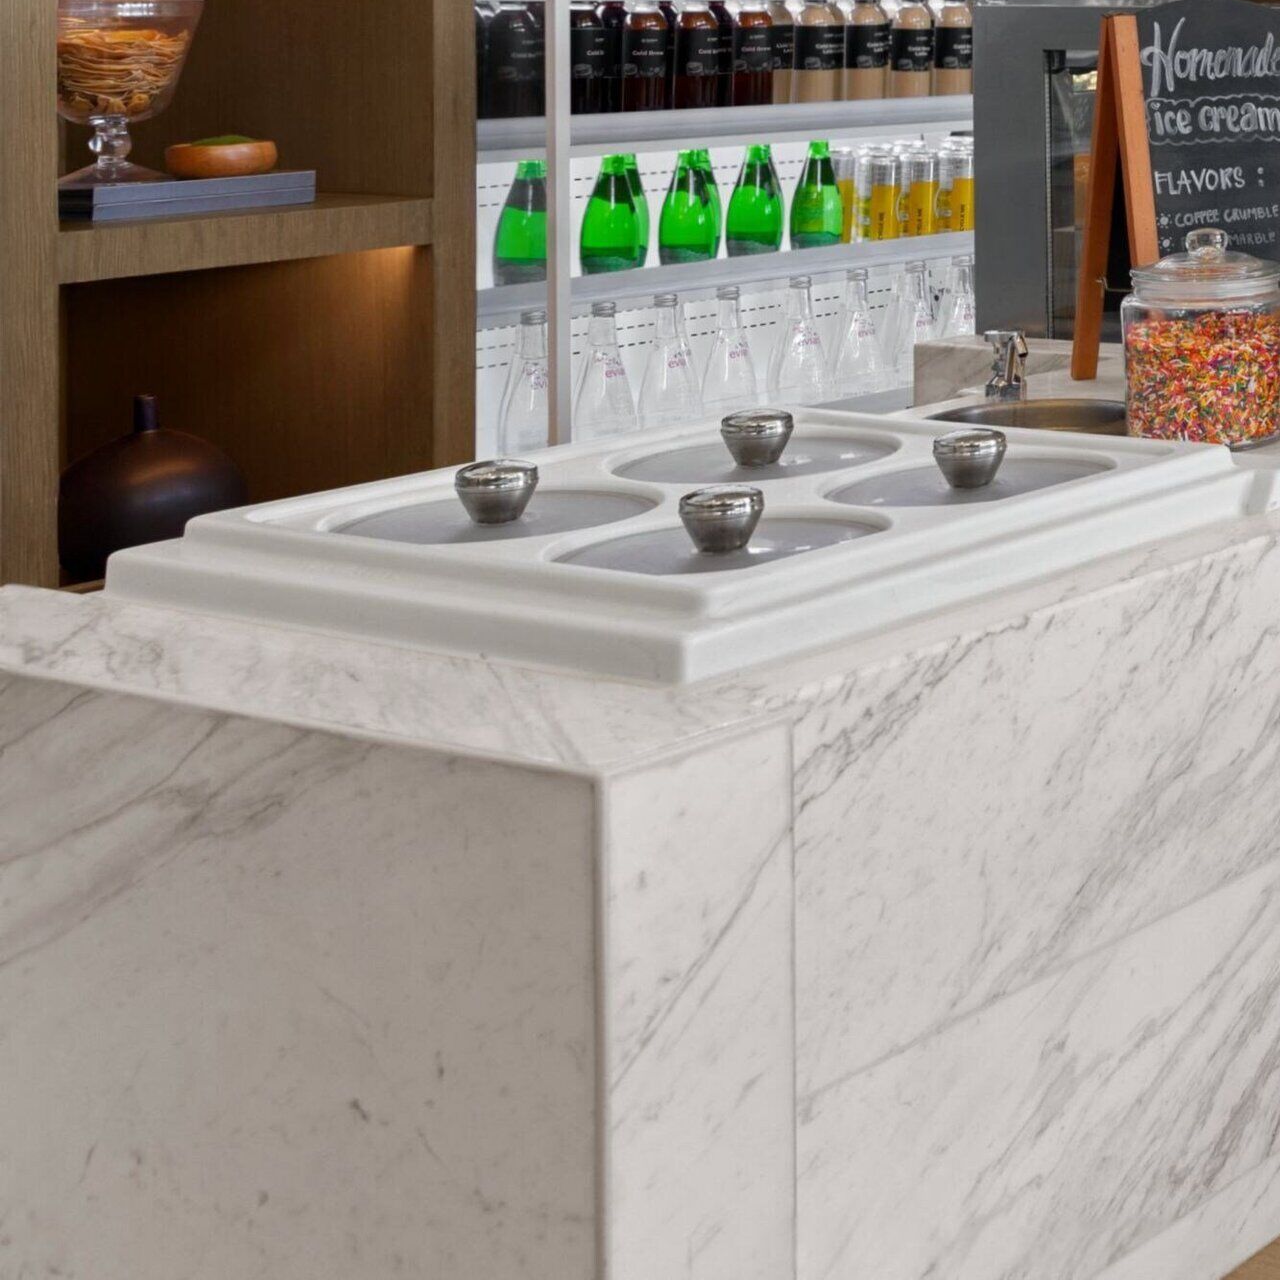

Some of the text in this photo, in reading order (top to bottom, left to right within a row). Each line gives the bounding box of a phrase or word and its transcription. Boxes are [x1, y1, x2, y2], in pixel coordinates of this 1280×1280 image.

[1151, 102, 1193, 136] ice
[1154, 166, 1246, 196] FLAVORS
[1174, 204, 1280, 228] COFFEE CRUMBLE
[1227, 231, 1276, 247] MARBLE
[605, 368, 626, 378] evia
